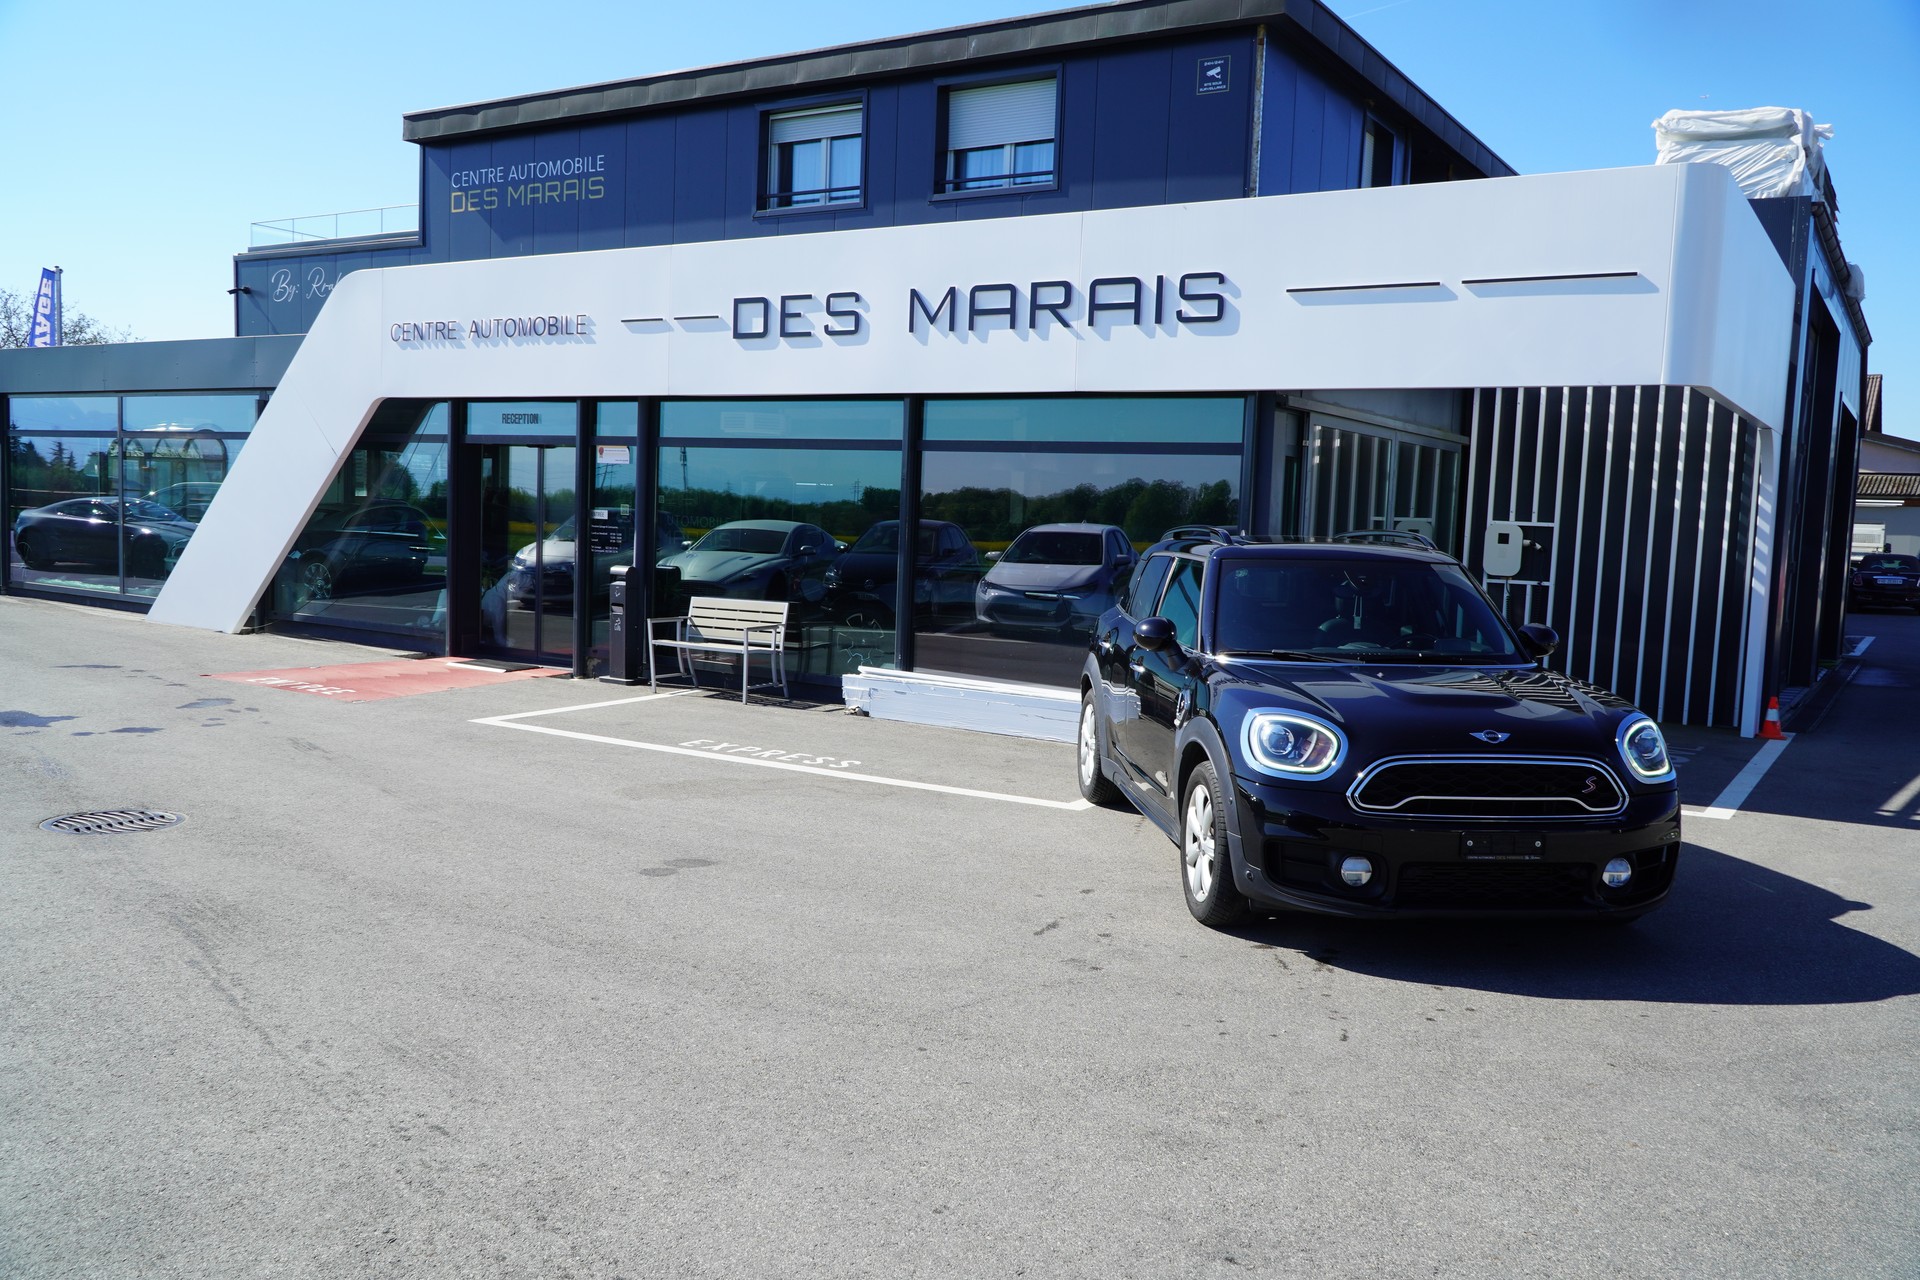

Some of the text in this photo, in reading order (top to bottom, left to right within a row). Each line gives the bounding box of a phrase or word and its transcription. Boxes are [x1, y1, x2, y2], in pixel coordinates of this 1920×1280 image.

[451, 154, 605, 189] CENTRE AUTOMOBILE
[451, 176, 605, 213] DES MARAIS
[306, 266, 342, 299] Rra
[733, 271, 1226, 340] DES MARAIS
[390, 314, 588, 343] CENTRE AUTOMOBILE
[501, 413, 539, 425] RECEPTION
[678, 739, 862, 768] EXPRESS
